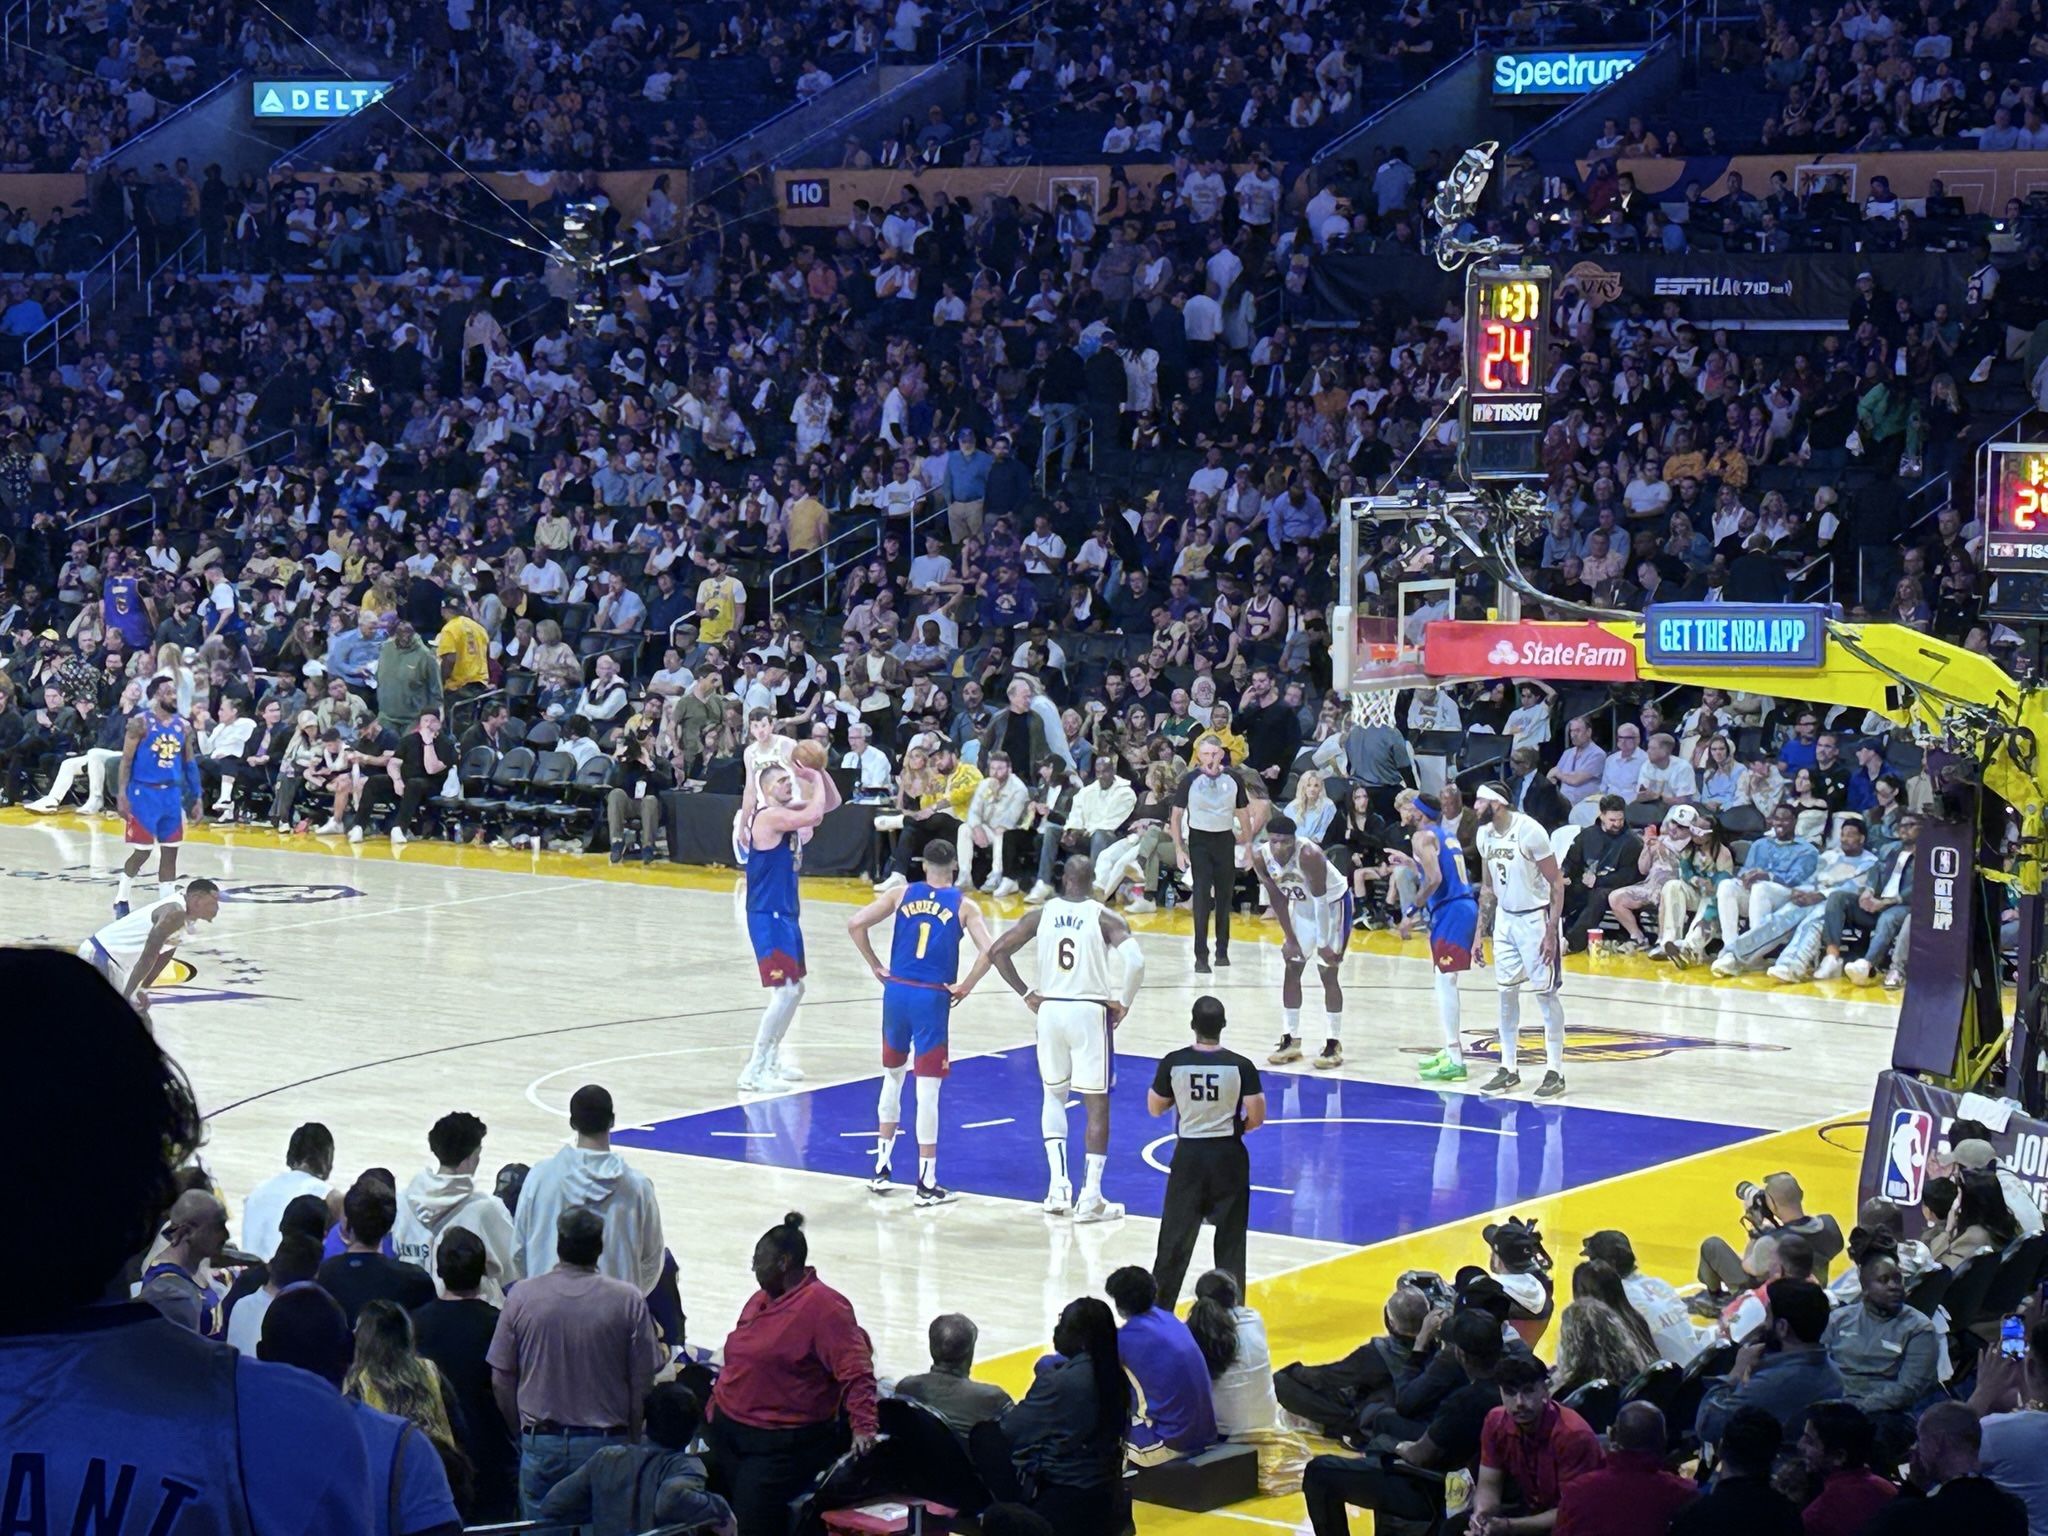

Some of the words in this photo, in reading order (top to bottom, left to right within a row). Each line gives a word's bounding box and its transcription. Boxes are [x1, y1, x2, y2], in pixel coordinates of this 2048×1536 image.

[792, 183, 823, 204] 110
[1500, 284, 1539, 323] 1:37
[1484, 325, 1532, 390] 24
[1659, 618, 1692, 652] GET
[1694, 618, 1729, 652] THE
[1730, 619, 1768, 653] NBA
[1768, 619, 1806, 653] APP
[1520, 640, 1575, 667] State
[1574, 642, 1627, 668] Farm
[915, 921, 931, 959] 1
[1058, 937, 1075, 970] 6
[1190, 1073, 1219, 1101] 55
